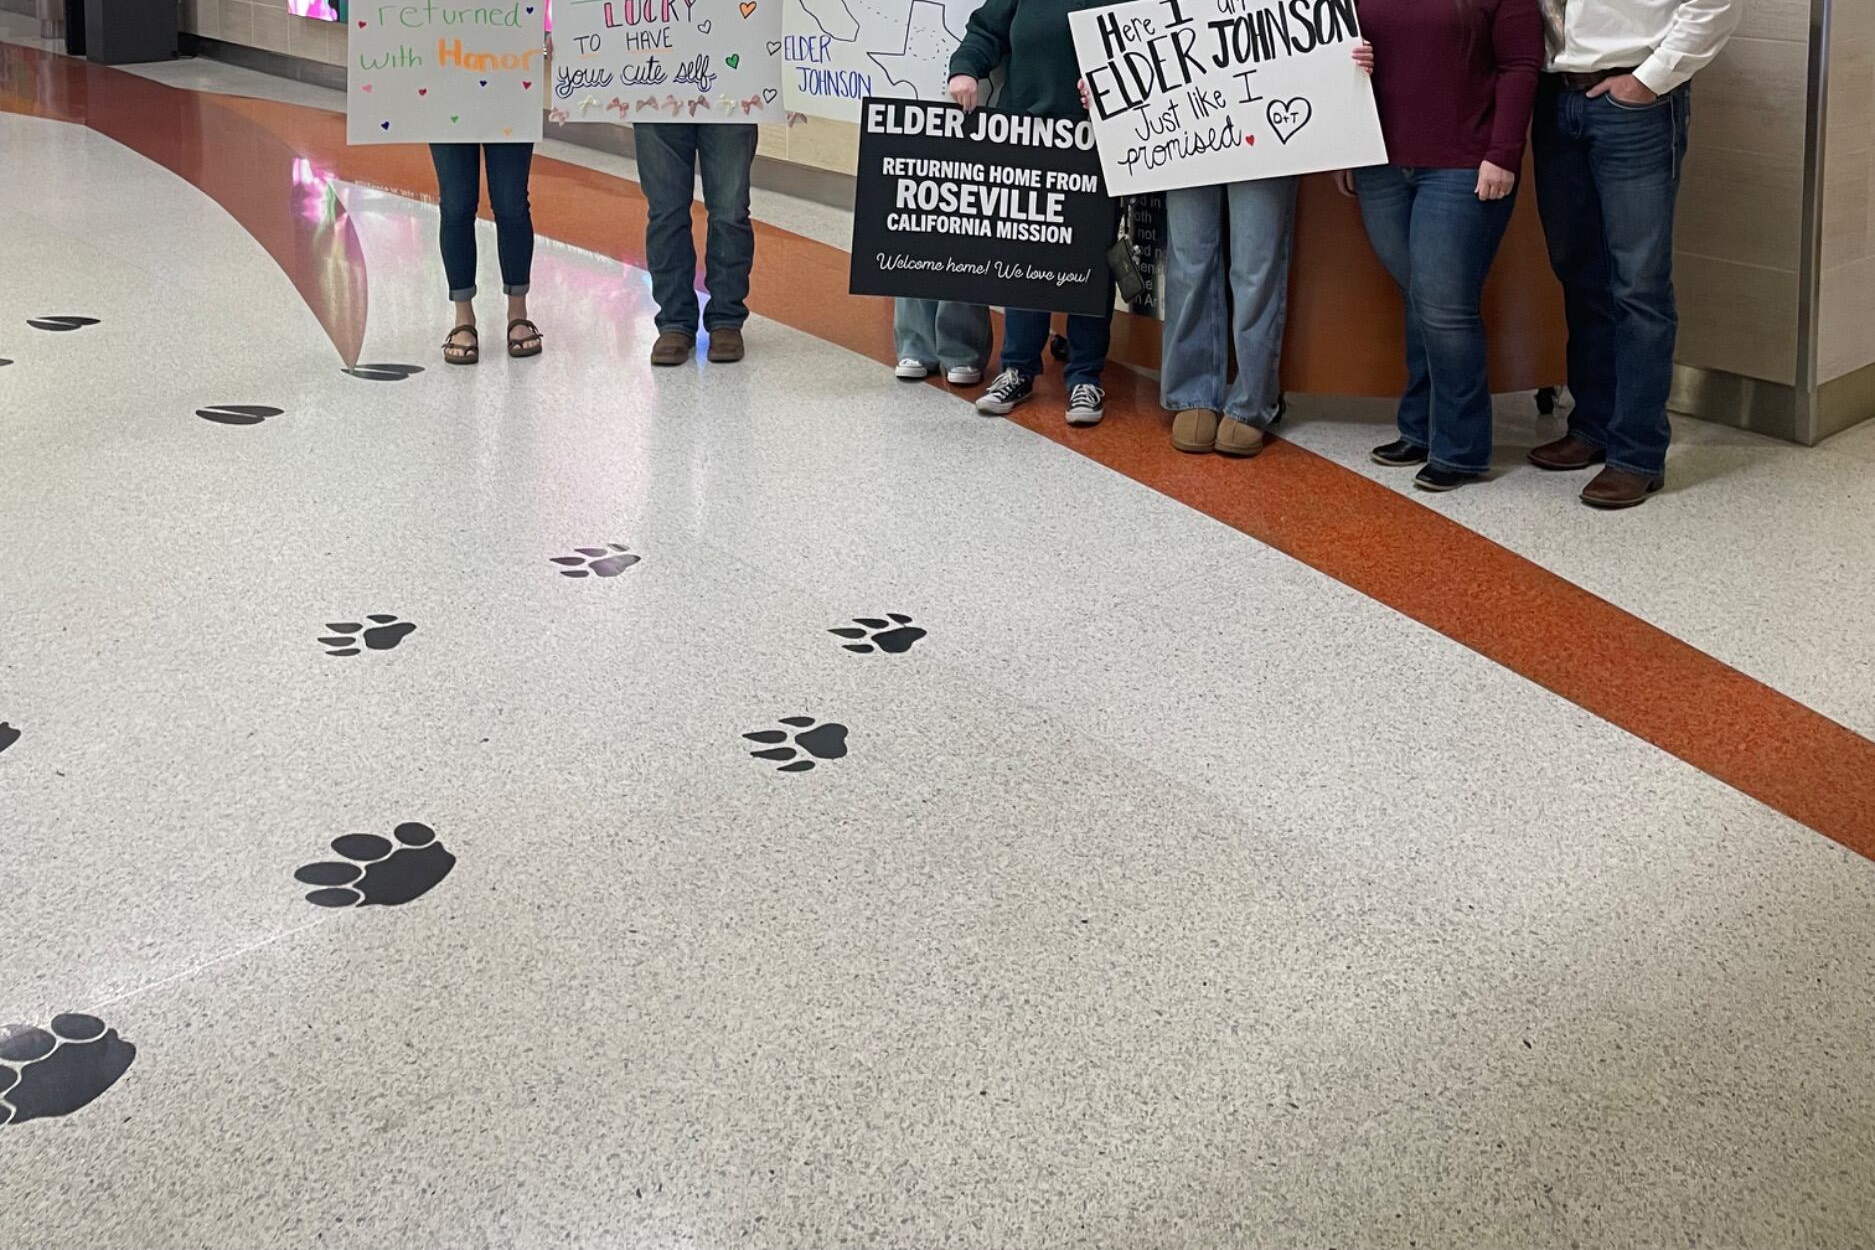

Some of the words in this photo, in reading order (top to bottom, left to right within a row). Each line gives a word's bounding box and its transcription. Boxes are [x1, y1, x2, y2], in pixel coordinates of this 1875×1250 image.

[573, 33, 602, 54] TO
[626, 26, 673, 52] HAVE
[784, 35, 832, 64] ELDER
[1097, 11, 1156, 60] Here
[360, 45, 423, 71] with
[438, 37, 541, 72] Honor
[556, 64, 614, 98] your
[621, 55, 668, 86] cute
[673, 53, 718, 92] self
[795, 67, 872, 99] JOHNSON
[1085, 28, 1207, 121] ELDER
[1132, 99, 1182, 142] Just
[1186, 86, 1226, 120] like
[1232, 69, 1264, 104] I
[867, 103, 965, 139] ELDER
[969, 111, 1096, 151] JOHNSO
[882, 157, 985, 182] RETURNING
[988, 166, 1042, 188] HOME
[1046, 171, 1098, 193] FROM
[896, 179, 1066, 223] ROSEVILLE
[886, 212, 992, 237] CALIFORNIA
[996, 221, 1073, 245] MISSION
[876, 252, 945, 272] Welcome
[946, 258, 991, 276] home!
[994, 261, 1025, 279] We
[1026, 266, 1055, 283] love
[1057, 268, 1092, 287] you!
